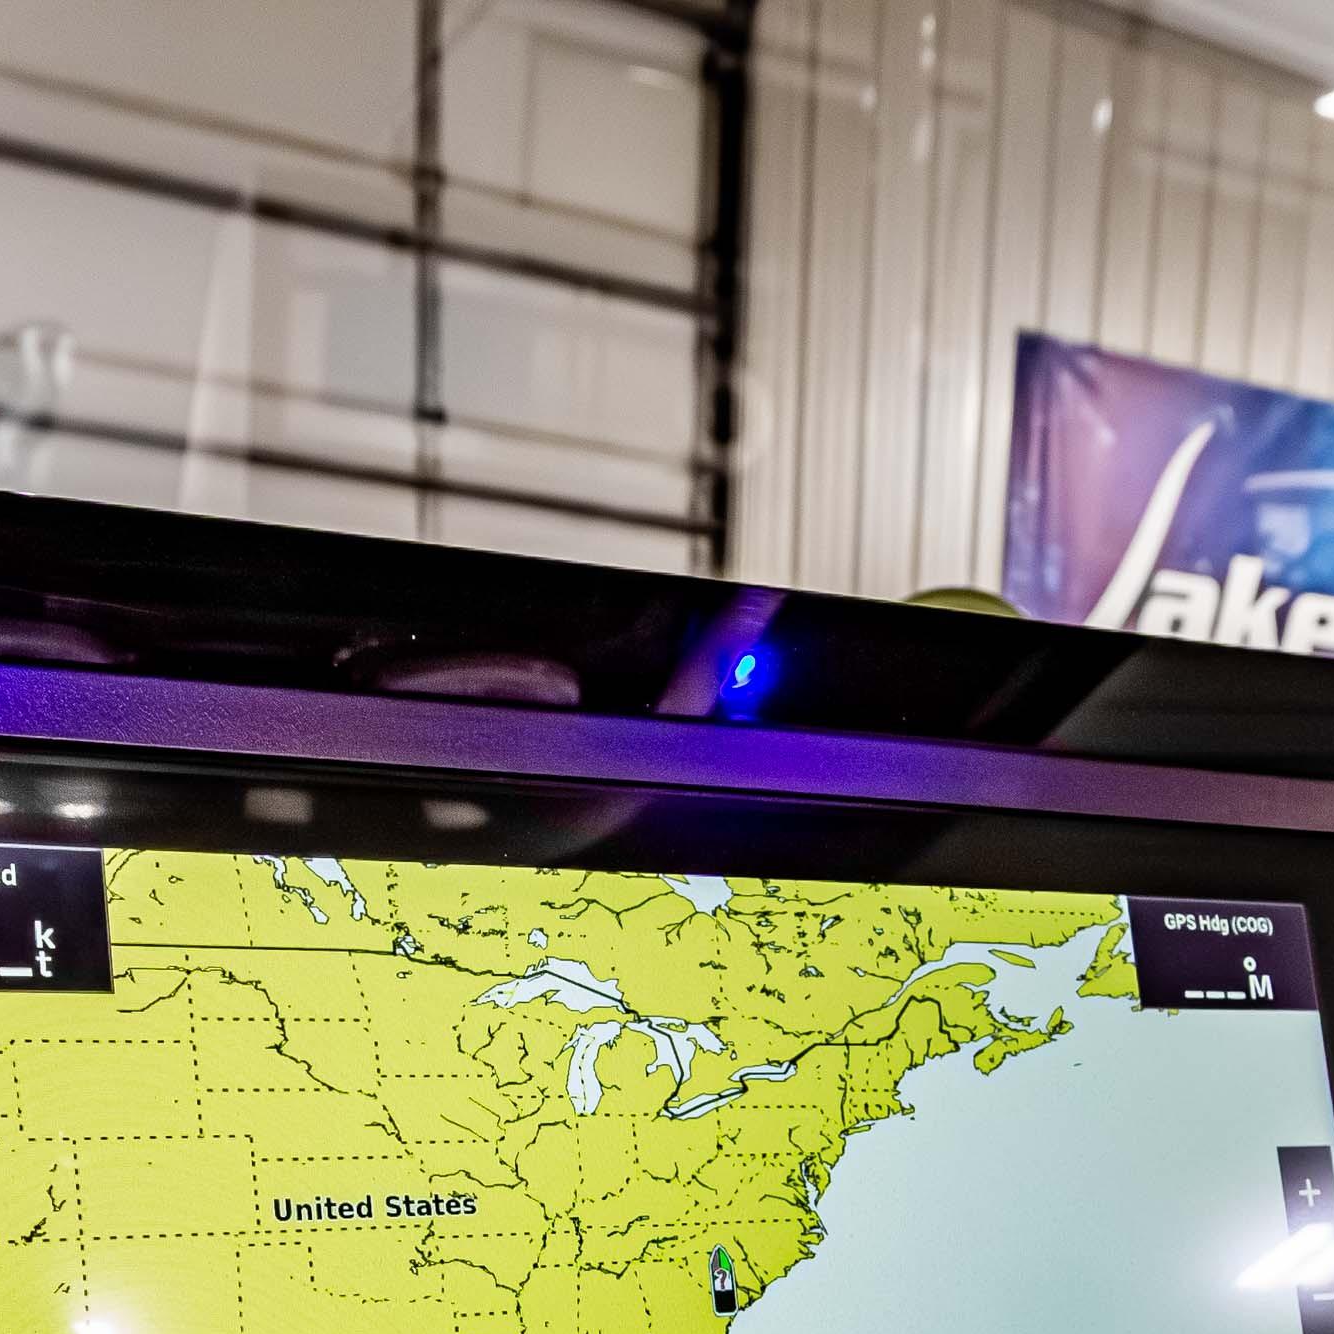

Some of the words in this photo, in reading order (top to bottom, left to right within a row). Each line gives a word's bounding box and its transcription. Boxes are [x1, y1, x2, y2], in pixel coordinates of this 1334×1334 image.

[1163, 912, 1197, 931] GPS
[1199, 914, 1230, 936] Hdg
[1231, 916, 1274, 937] (COG)
[273, 1194, 373, 1222] United
[385, 1193, 478, 1218] States
